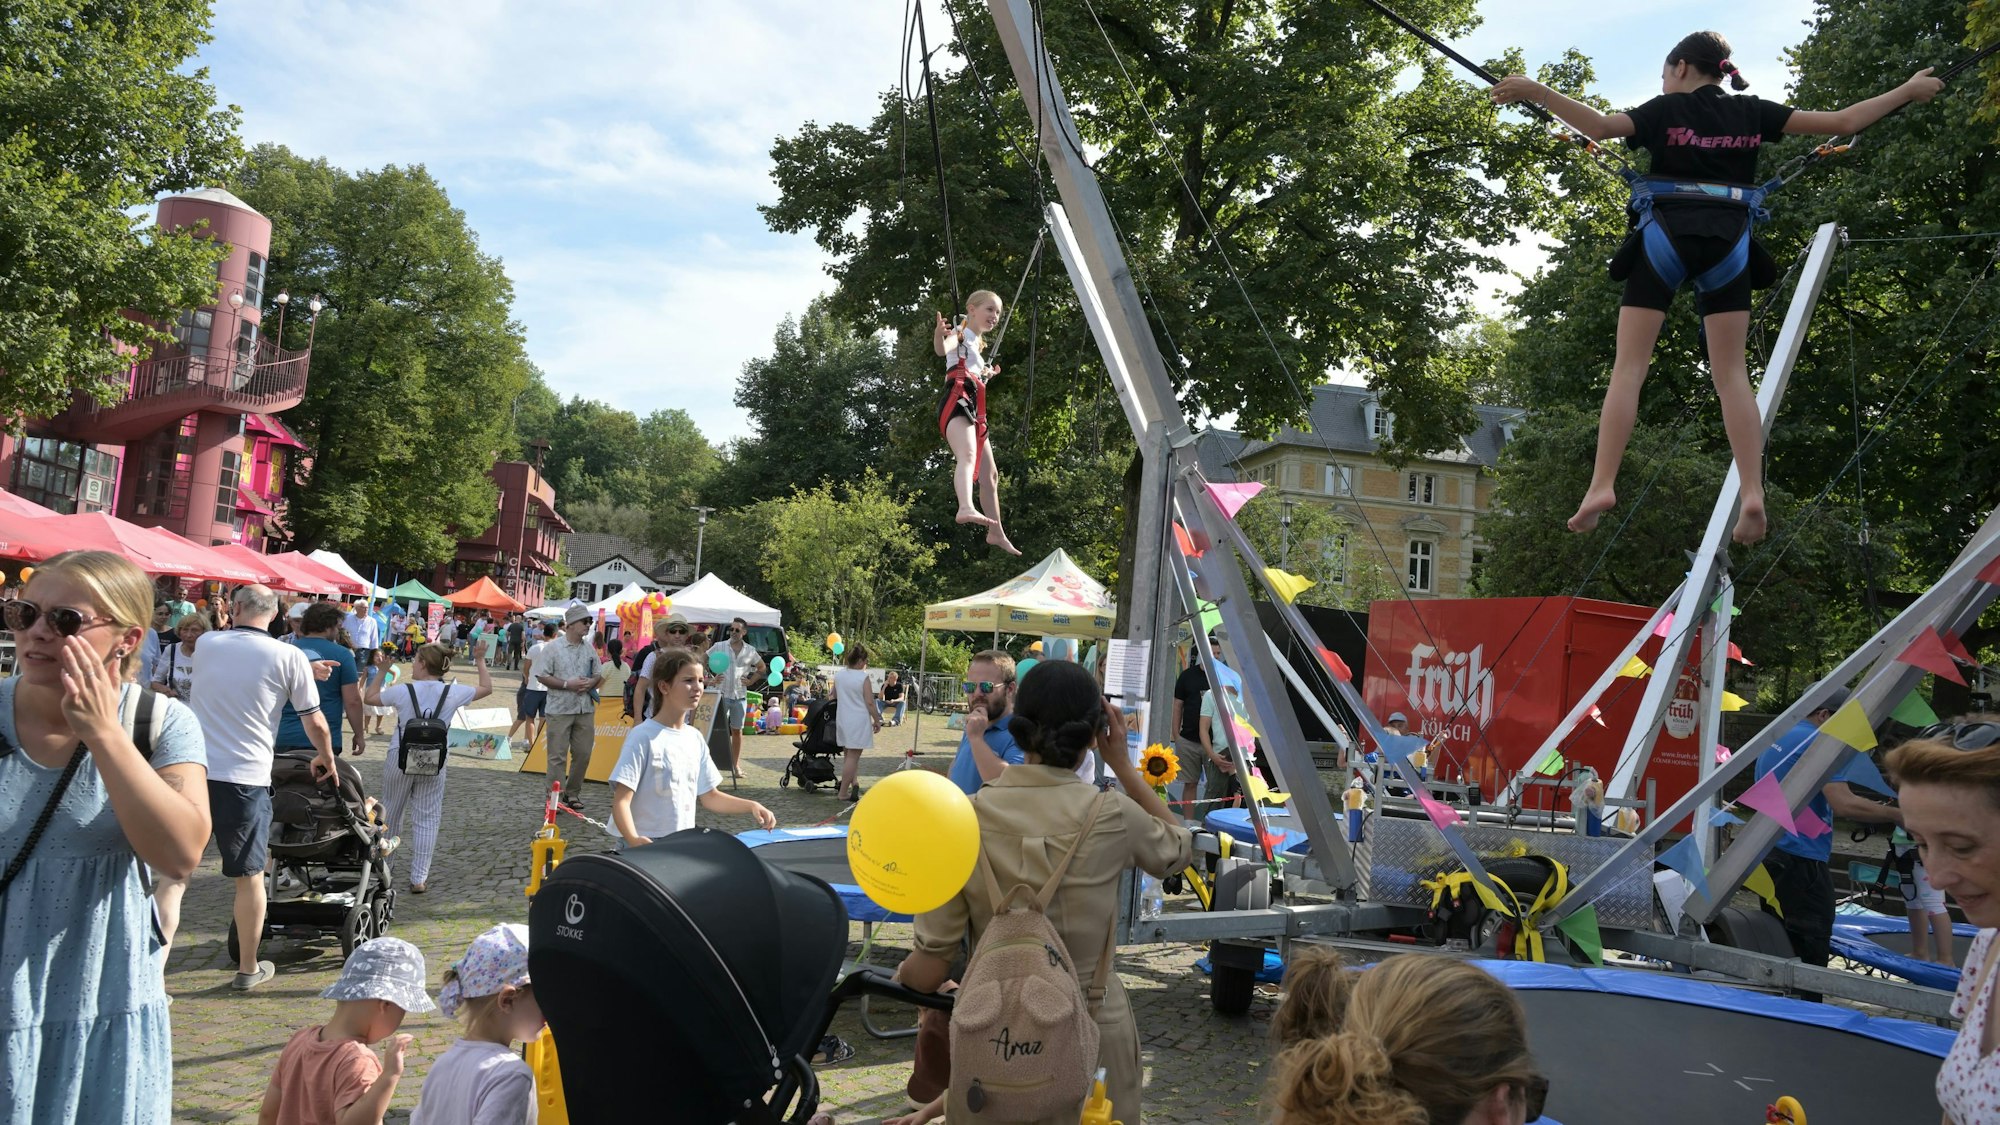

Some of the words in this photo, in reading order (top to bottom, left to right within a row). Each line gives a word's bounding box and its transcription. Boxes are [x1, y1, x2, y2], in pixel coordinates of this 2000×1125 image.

[882, 861, 897, 872] 40
[556, 925, 584, 940] STOKKE
[989, 1027, 1044, 1061] Araz
